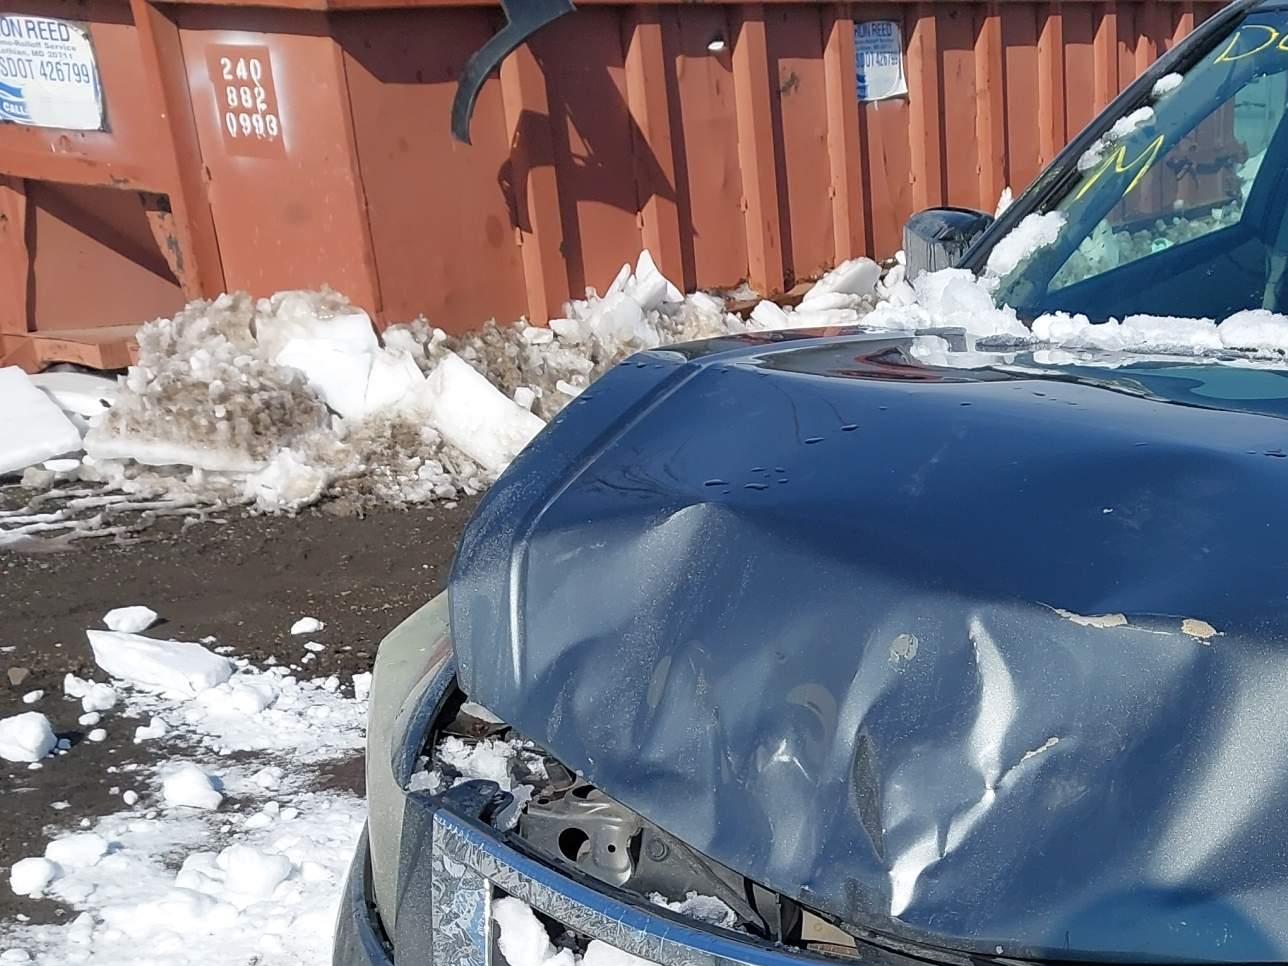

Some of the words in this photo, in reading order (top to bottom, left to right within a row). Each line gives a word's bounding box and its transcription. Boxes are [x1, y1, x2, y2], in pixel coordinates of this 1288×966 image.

[25, 20, 70, 42] REED
[40, 60, 90, 84] 426799
[220, 57, 262, 80] 240
